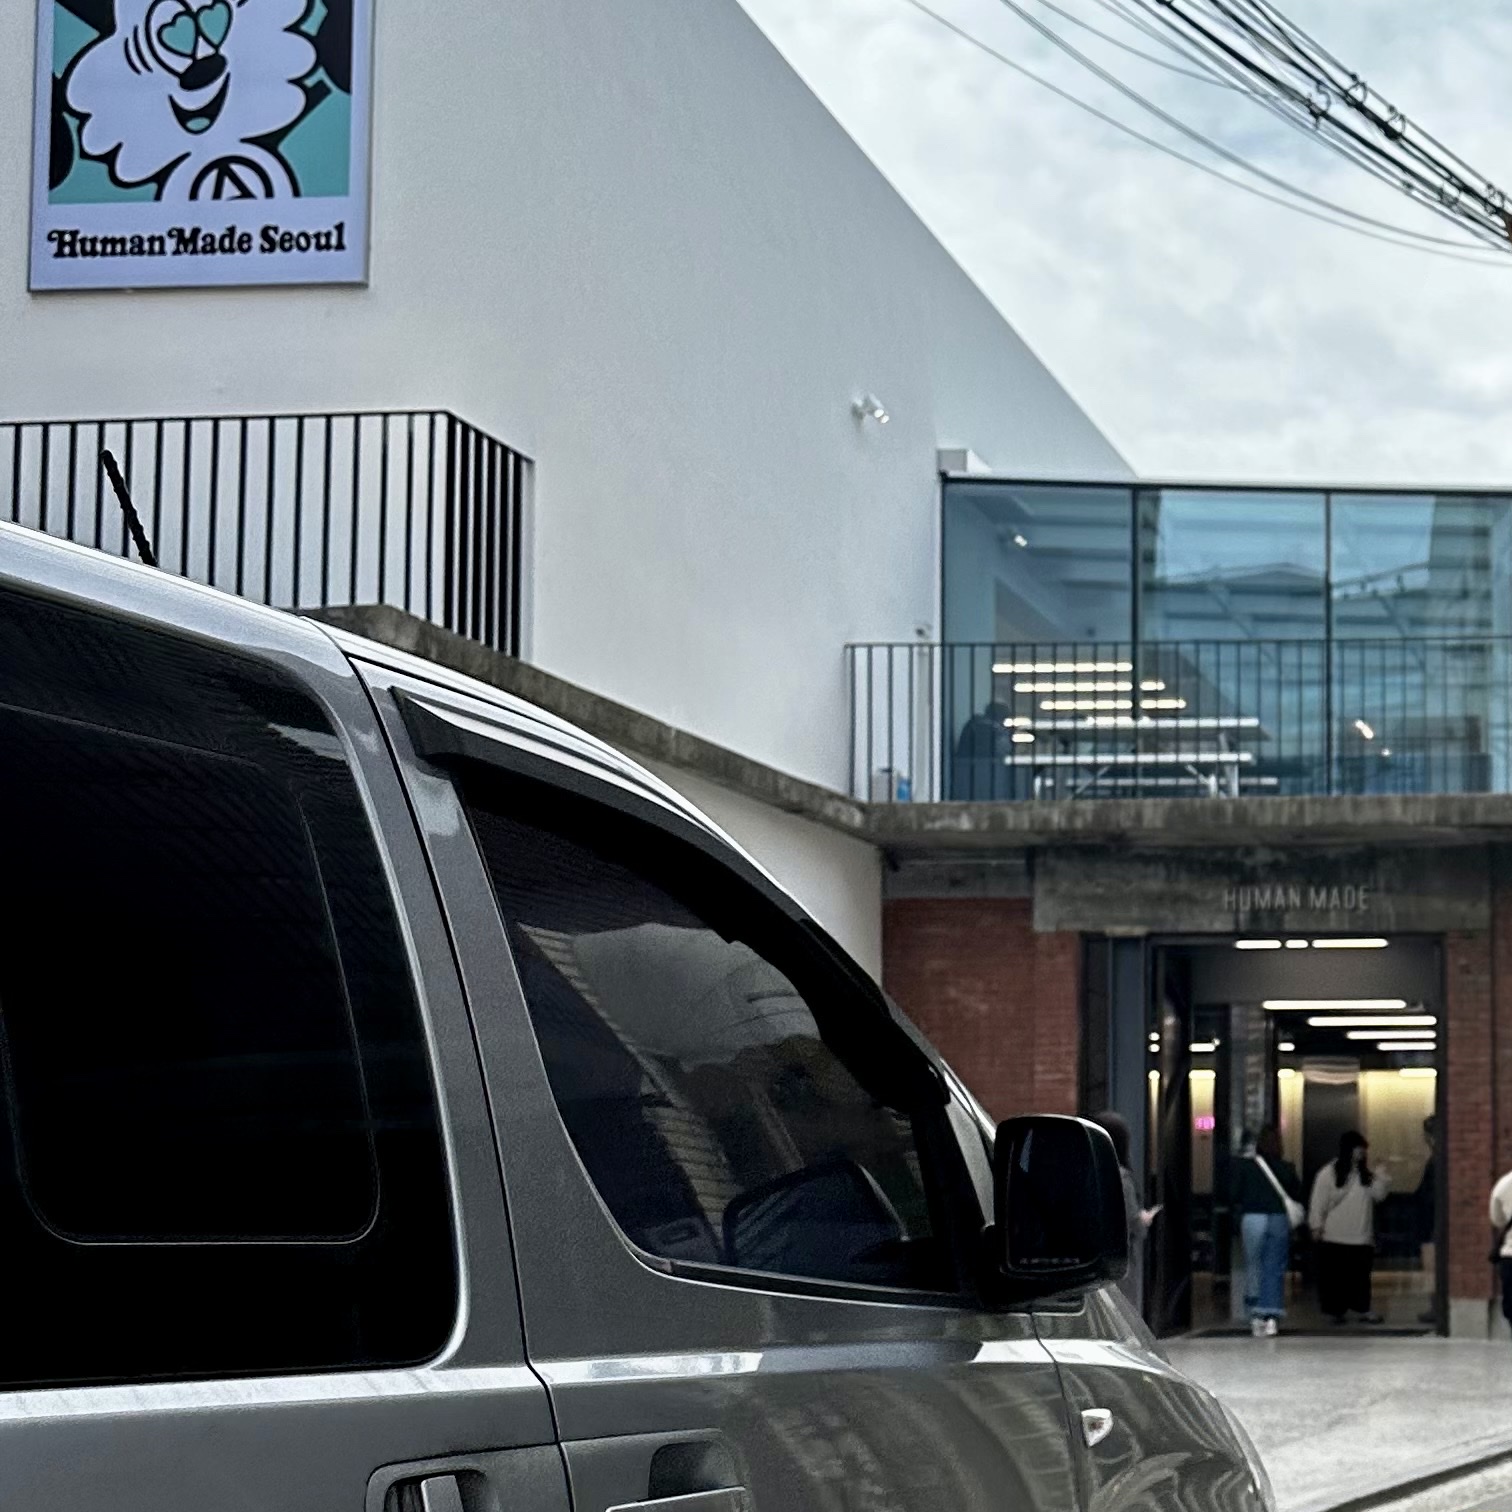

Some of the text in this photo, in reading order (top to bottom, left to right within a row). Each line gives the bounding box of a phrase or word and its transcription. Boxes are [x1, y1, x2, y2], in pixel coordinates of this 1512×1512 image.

[47, 221, 346, 258] Human Made Seoul
[1224, 885, 1369, 911] HUMAN MADE
